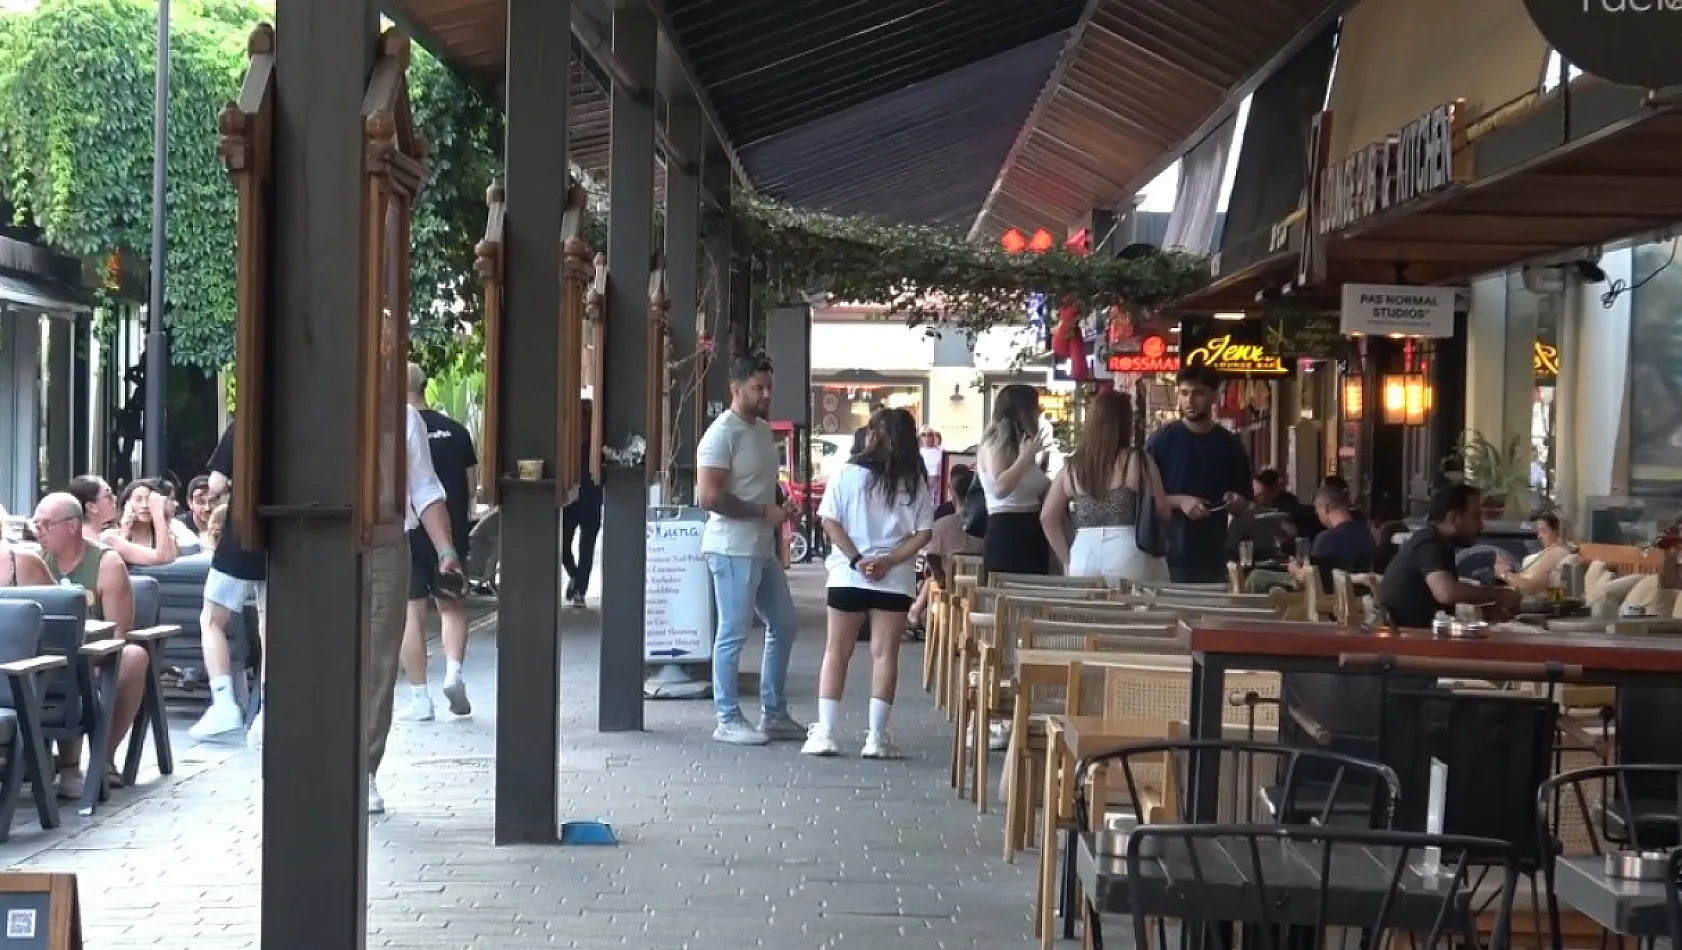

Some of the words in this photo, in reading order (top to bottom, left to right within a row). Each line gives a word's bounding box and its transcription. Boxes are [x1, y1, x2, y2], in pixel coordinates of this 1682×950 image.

[1396, 103, 1454, 203] KITCHEN
[1360, 294, 1383, 304] PAS
[1386, 294, 1439, 306] NORMAL
